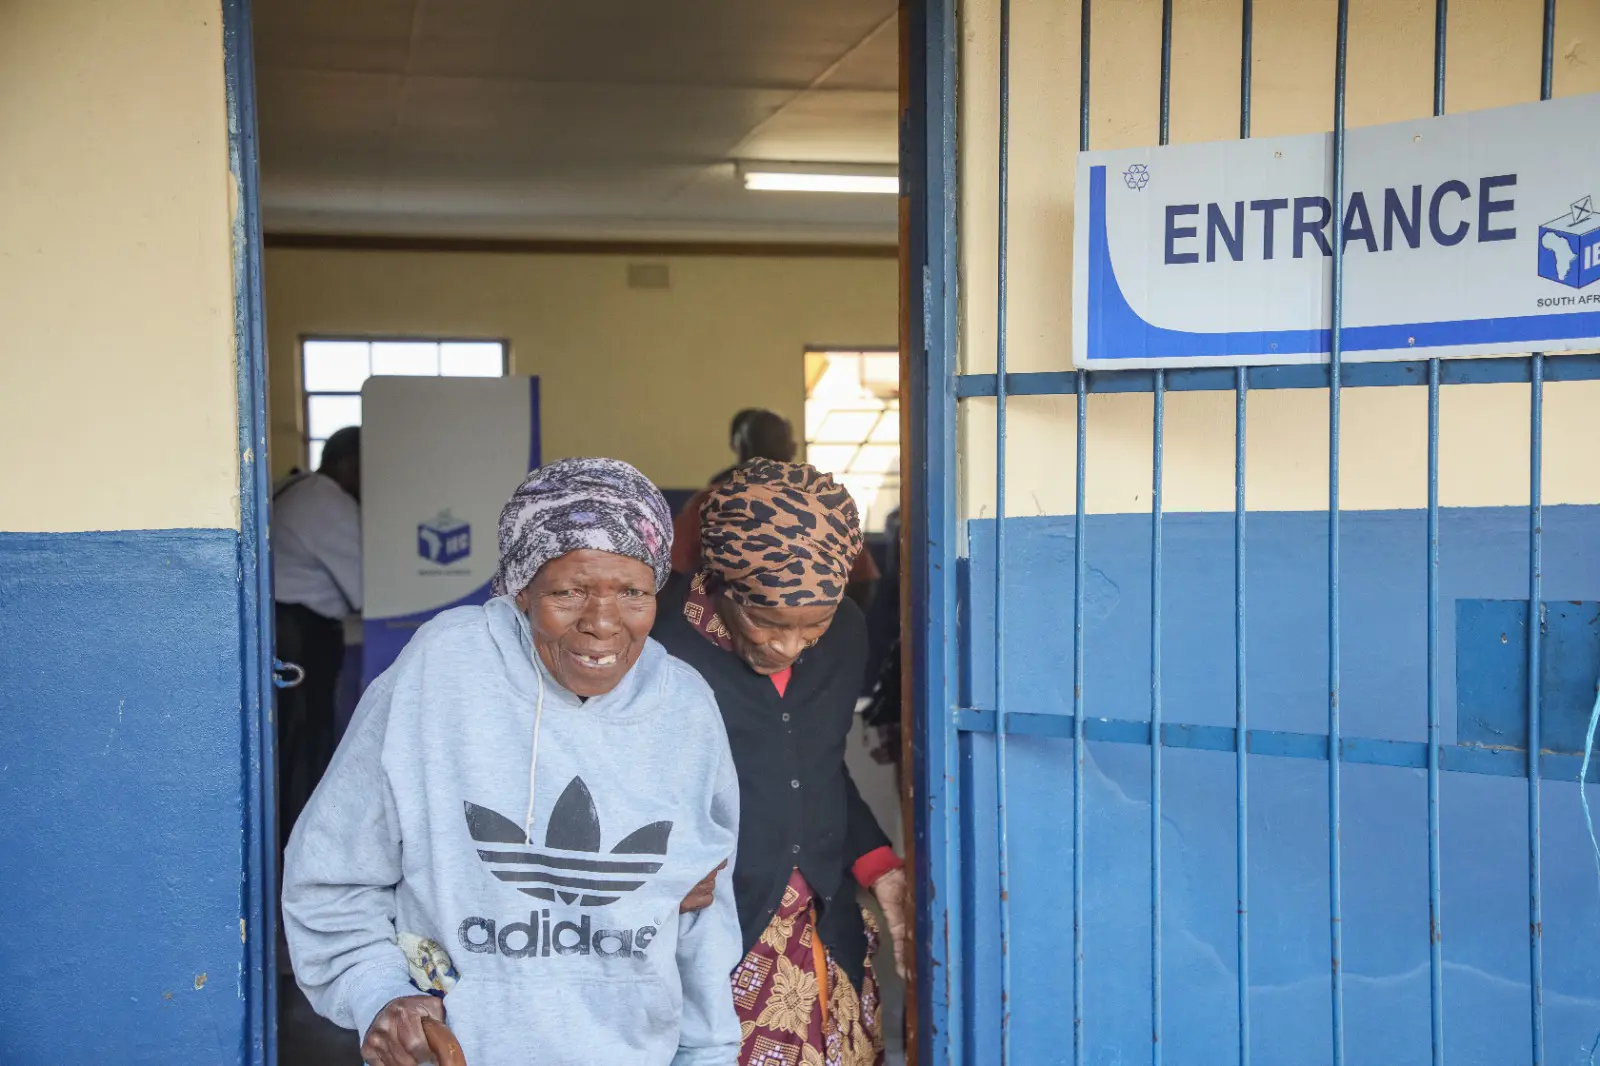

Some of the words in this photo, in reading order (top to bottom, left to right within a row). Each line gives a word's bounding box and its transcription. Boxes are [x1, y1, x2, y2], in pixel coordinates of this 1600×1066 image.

[1164, 174, 1518, 265] ENTRANCE
[1537, 297, 1575, 308] SOUTH
[458, 908, 657, 961] adidas
